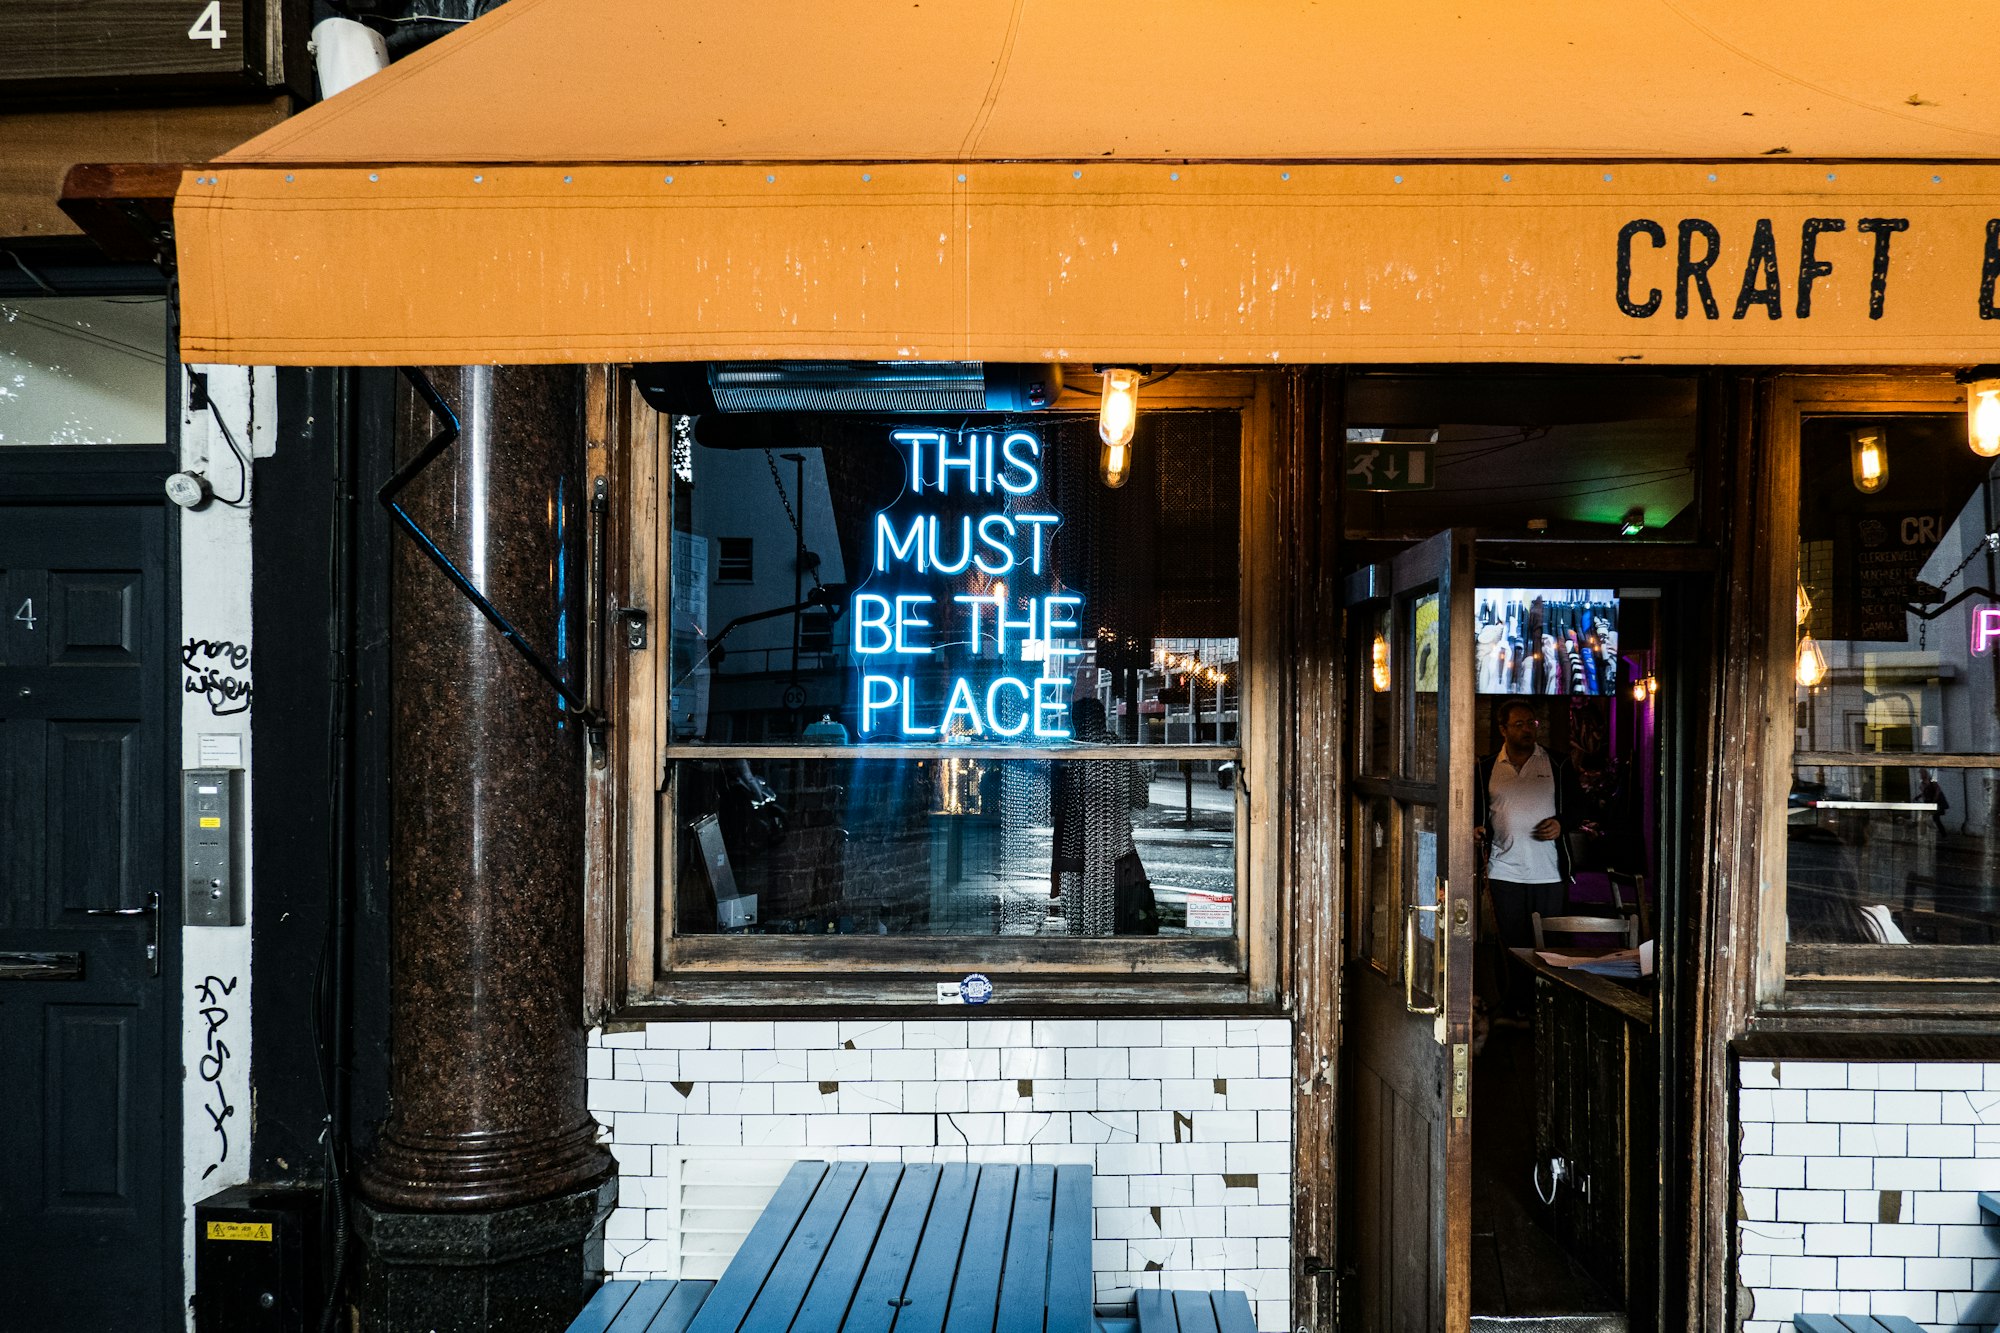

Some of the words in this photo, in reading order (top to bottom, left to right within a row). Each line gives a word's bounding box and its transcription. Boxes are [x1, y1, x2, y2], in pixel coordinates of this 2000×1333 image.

[187, 0, 227, 49] 4
[1615, 217, 1910, 321] CRAFT
[893, 430, 1040, 496] THIS
[875, 513, 1060, 576] MUST
[14, 597, 38, 631] 4
[854, 593, 934, 656] BE
[953, 594, 1082, 657] THE
[862, 674, 1072, 739] PLACE
